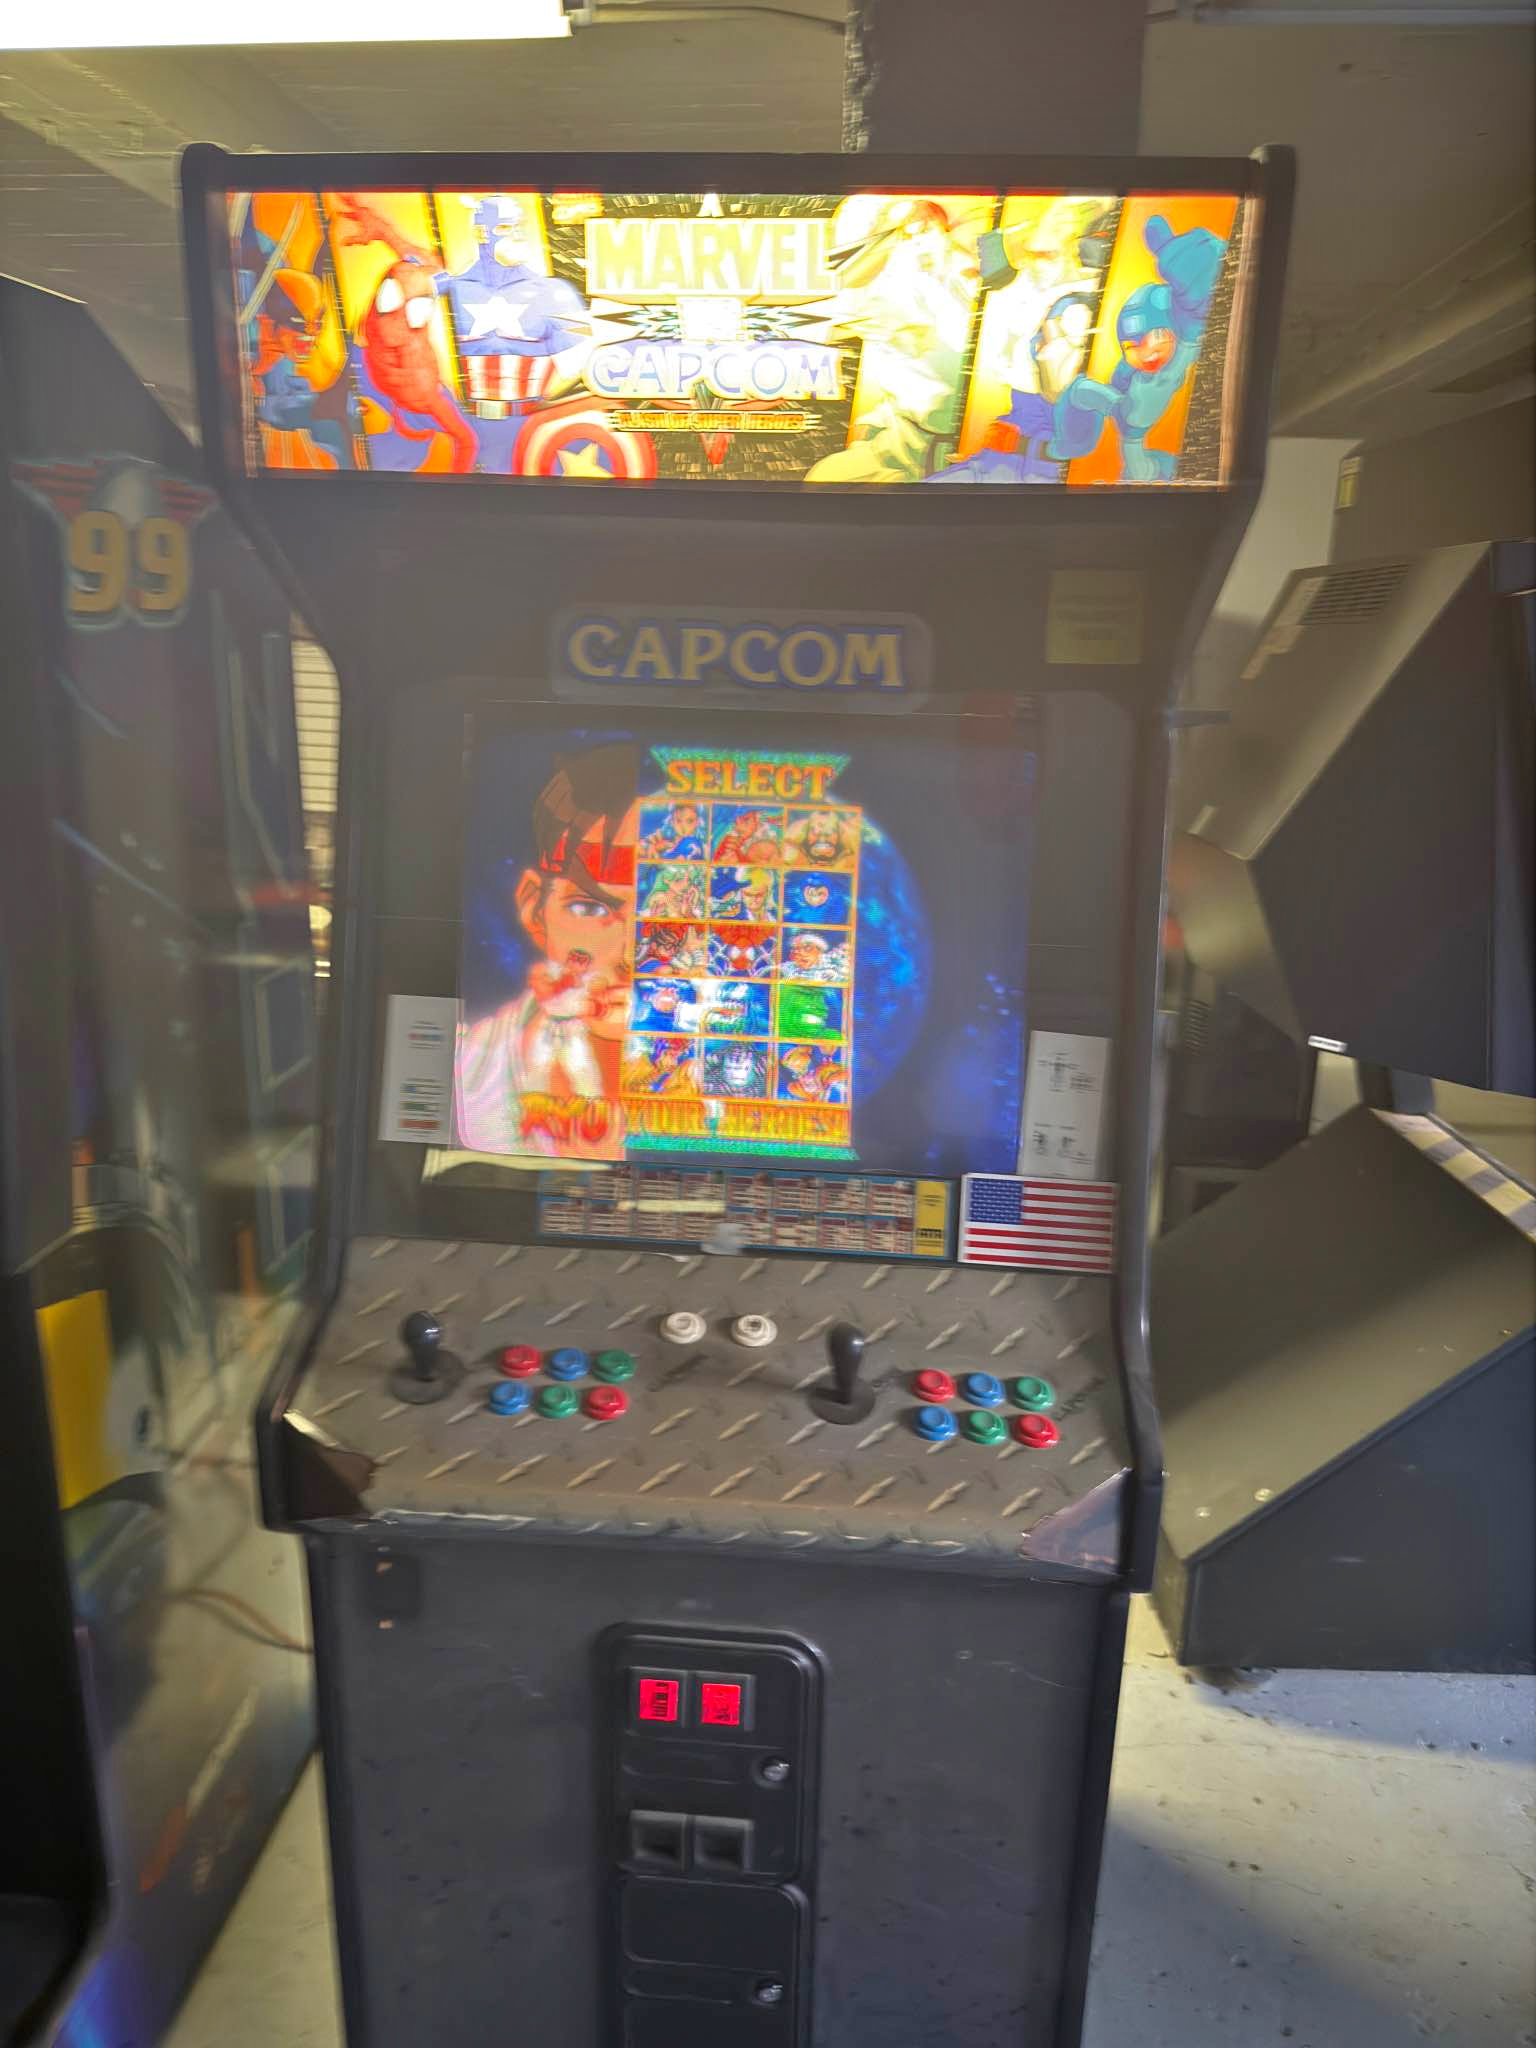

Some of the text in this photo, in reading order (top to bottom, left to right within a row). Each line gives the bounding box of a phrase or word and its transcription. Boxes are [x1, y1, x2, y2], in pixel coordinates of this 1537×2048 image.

[597, 221, 833, 291] MARVEL
[592, 351, 836, 396] CAPCOM
[69, 510, 190, 615] 99
[567, 622, 907, 689] CAPCOM
[666, 758, 835, 800] SELECT
